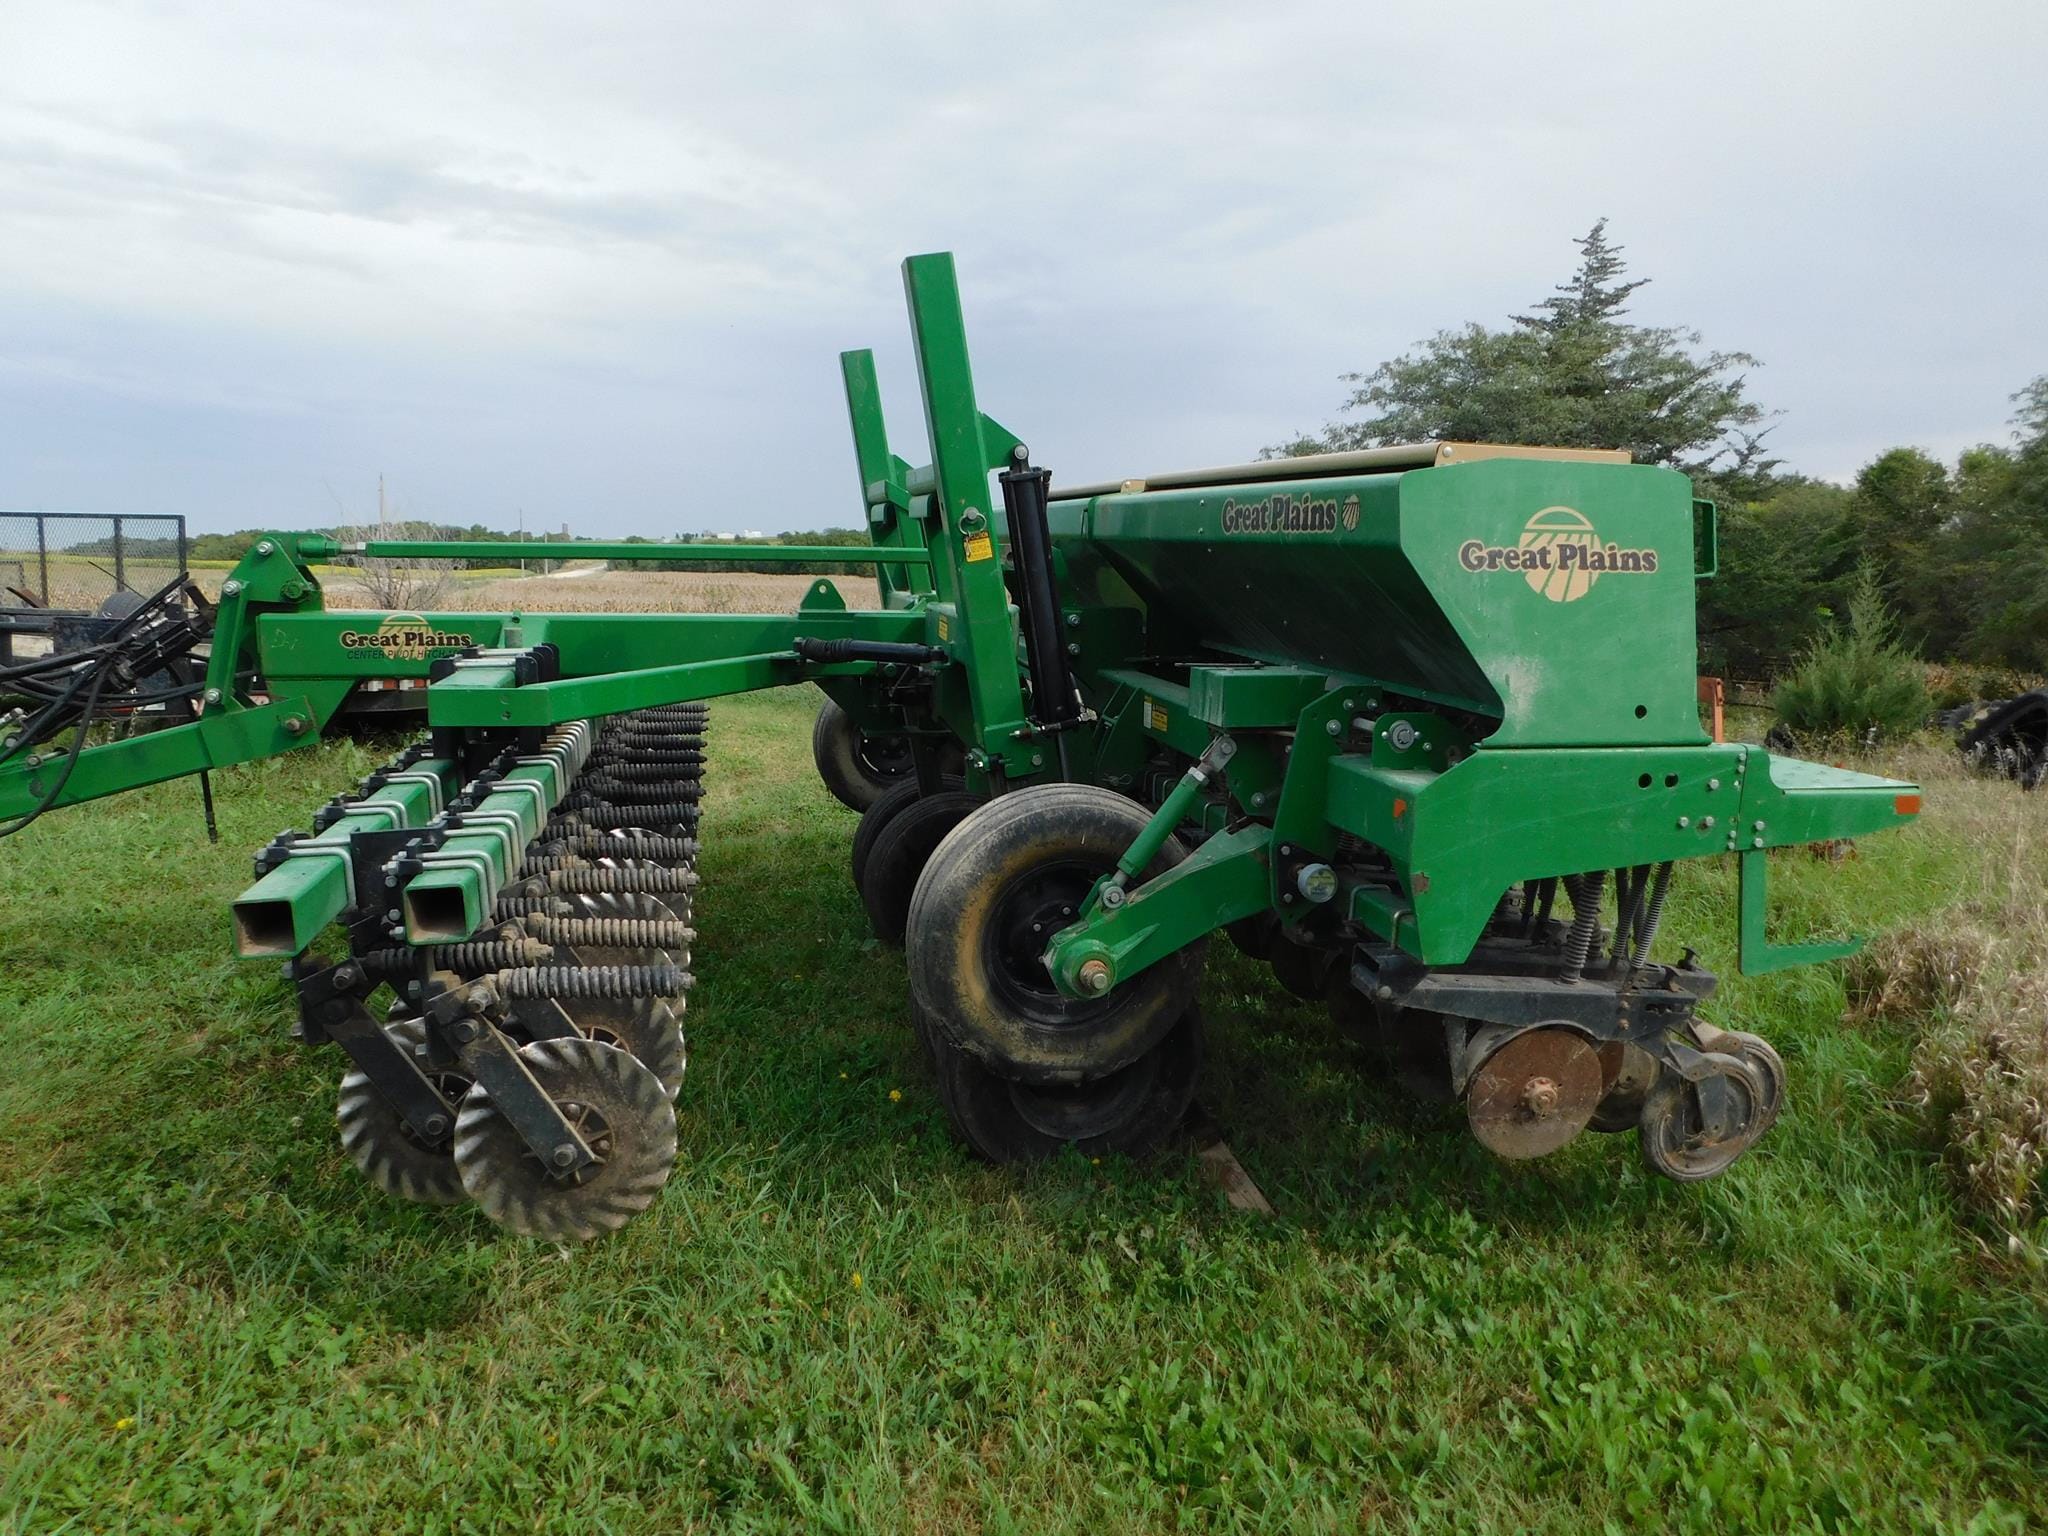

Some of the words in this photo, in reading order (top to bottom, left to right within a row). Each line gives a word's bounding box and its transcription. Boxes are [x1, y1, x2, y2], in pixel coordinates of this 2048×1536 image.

[1222, 497, 1270, 535] Great
[1270, 492, 1337, 533] Plains
[1459, 539, 1553, 572] Great
[1555, 542, 1658, 573] Plains
[340, 630, 401, 649] Great
[402, 630, 472, 648] Plains
[346, 649, 385, 660] CENTER
[388, 649, 415, 660] PIVOT
